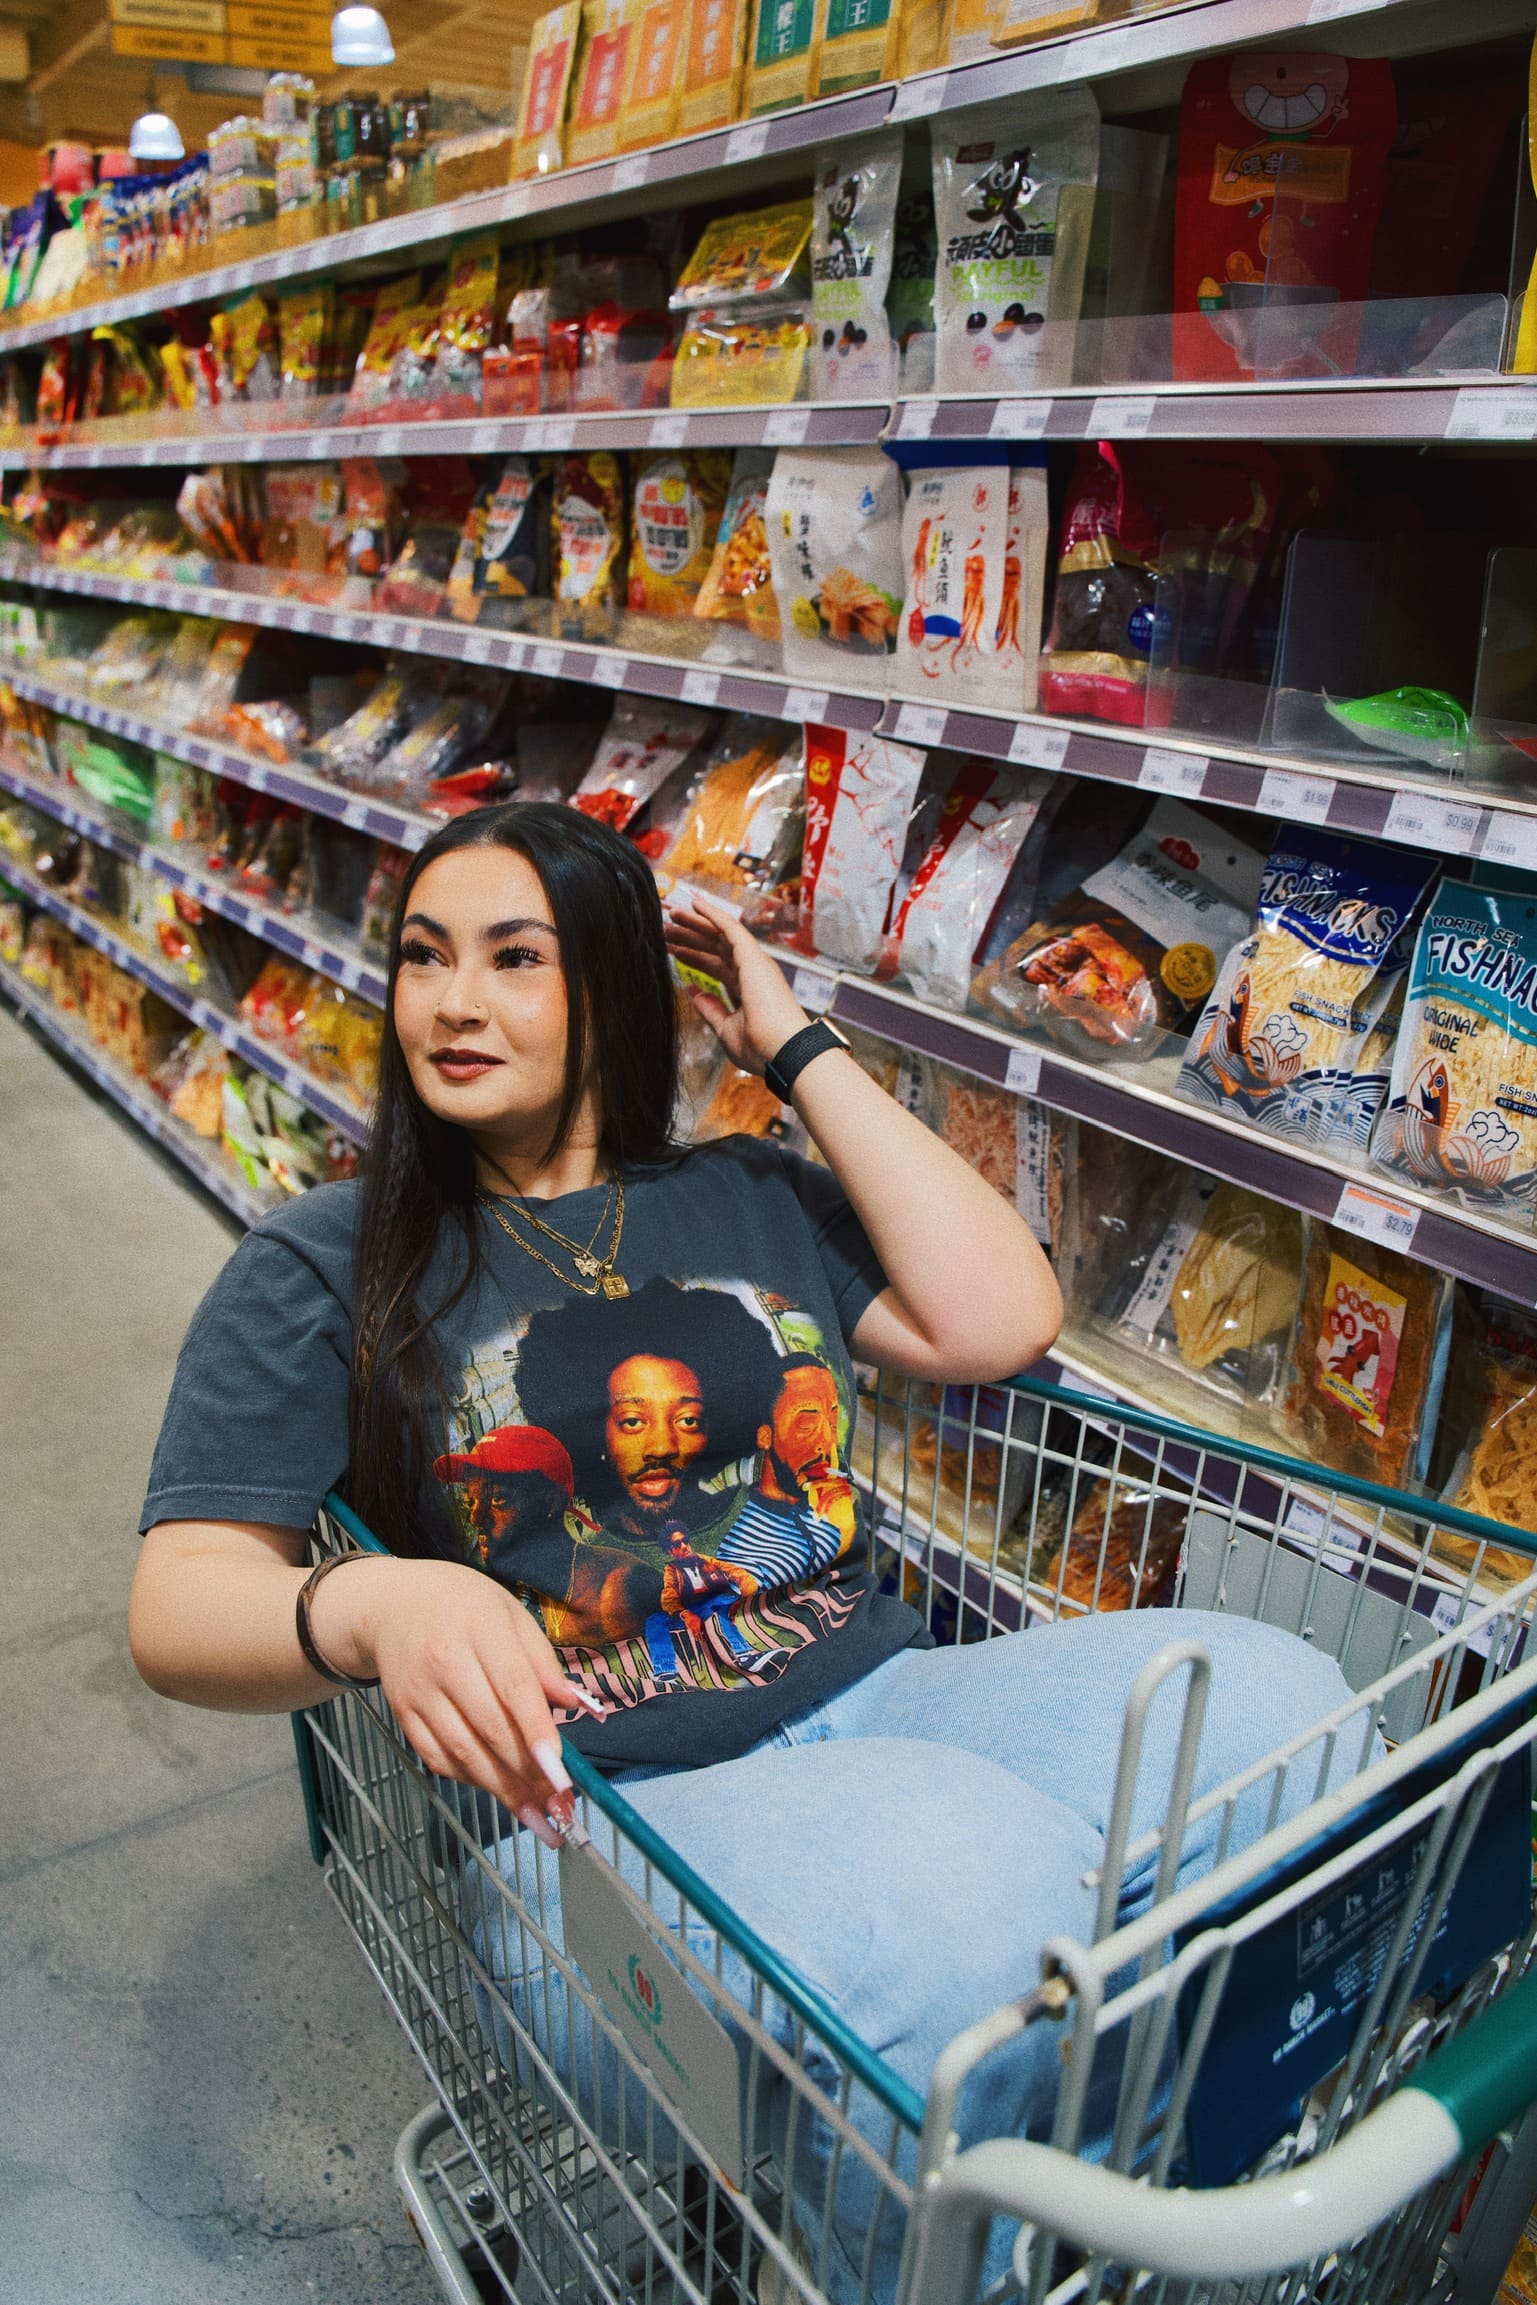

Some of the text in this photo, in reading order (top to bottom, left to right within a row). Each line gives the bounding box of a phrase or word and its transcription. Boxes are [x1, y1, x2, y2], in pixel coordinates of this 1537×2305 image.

[1431, 915, 1520, 950] NORTH SEA
[1423, 1004, 1480, 1038] ORIGINAL
[1428, 1028, 1460, 1054] WIDE
[1499, 1082, 1523, 1098] FISH
